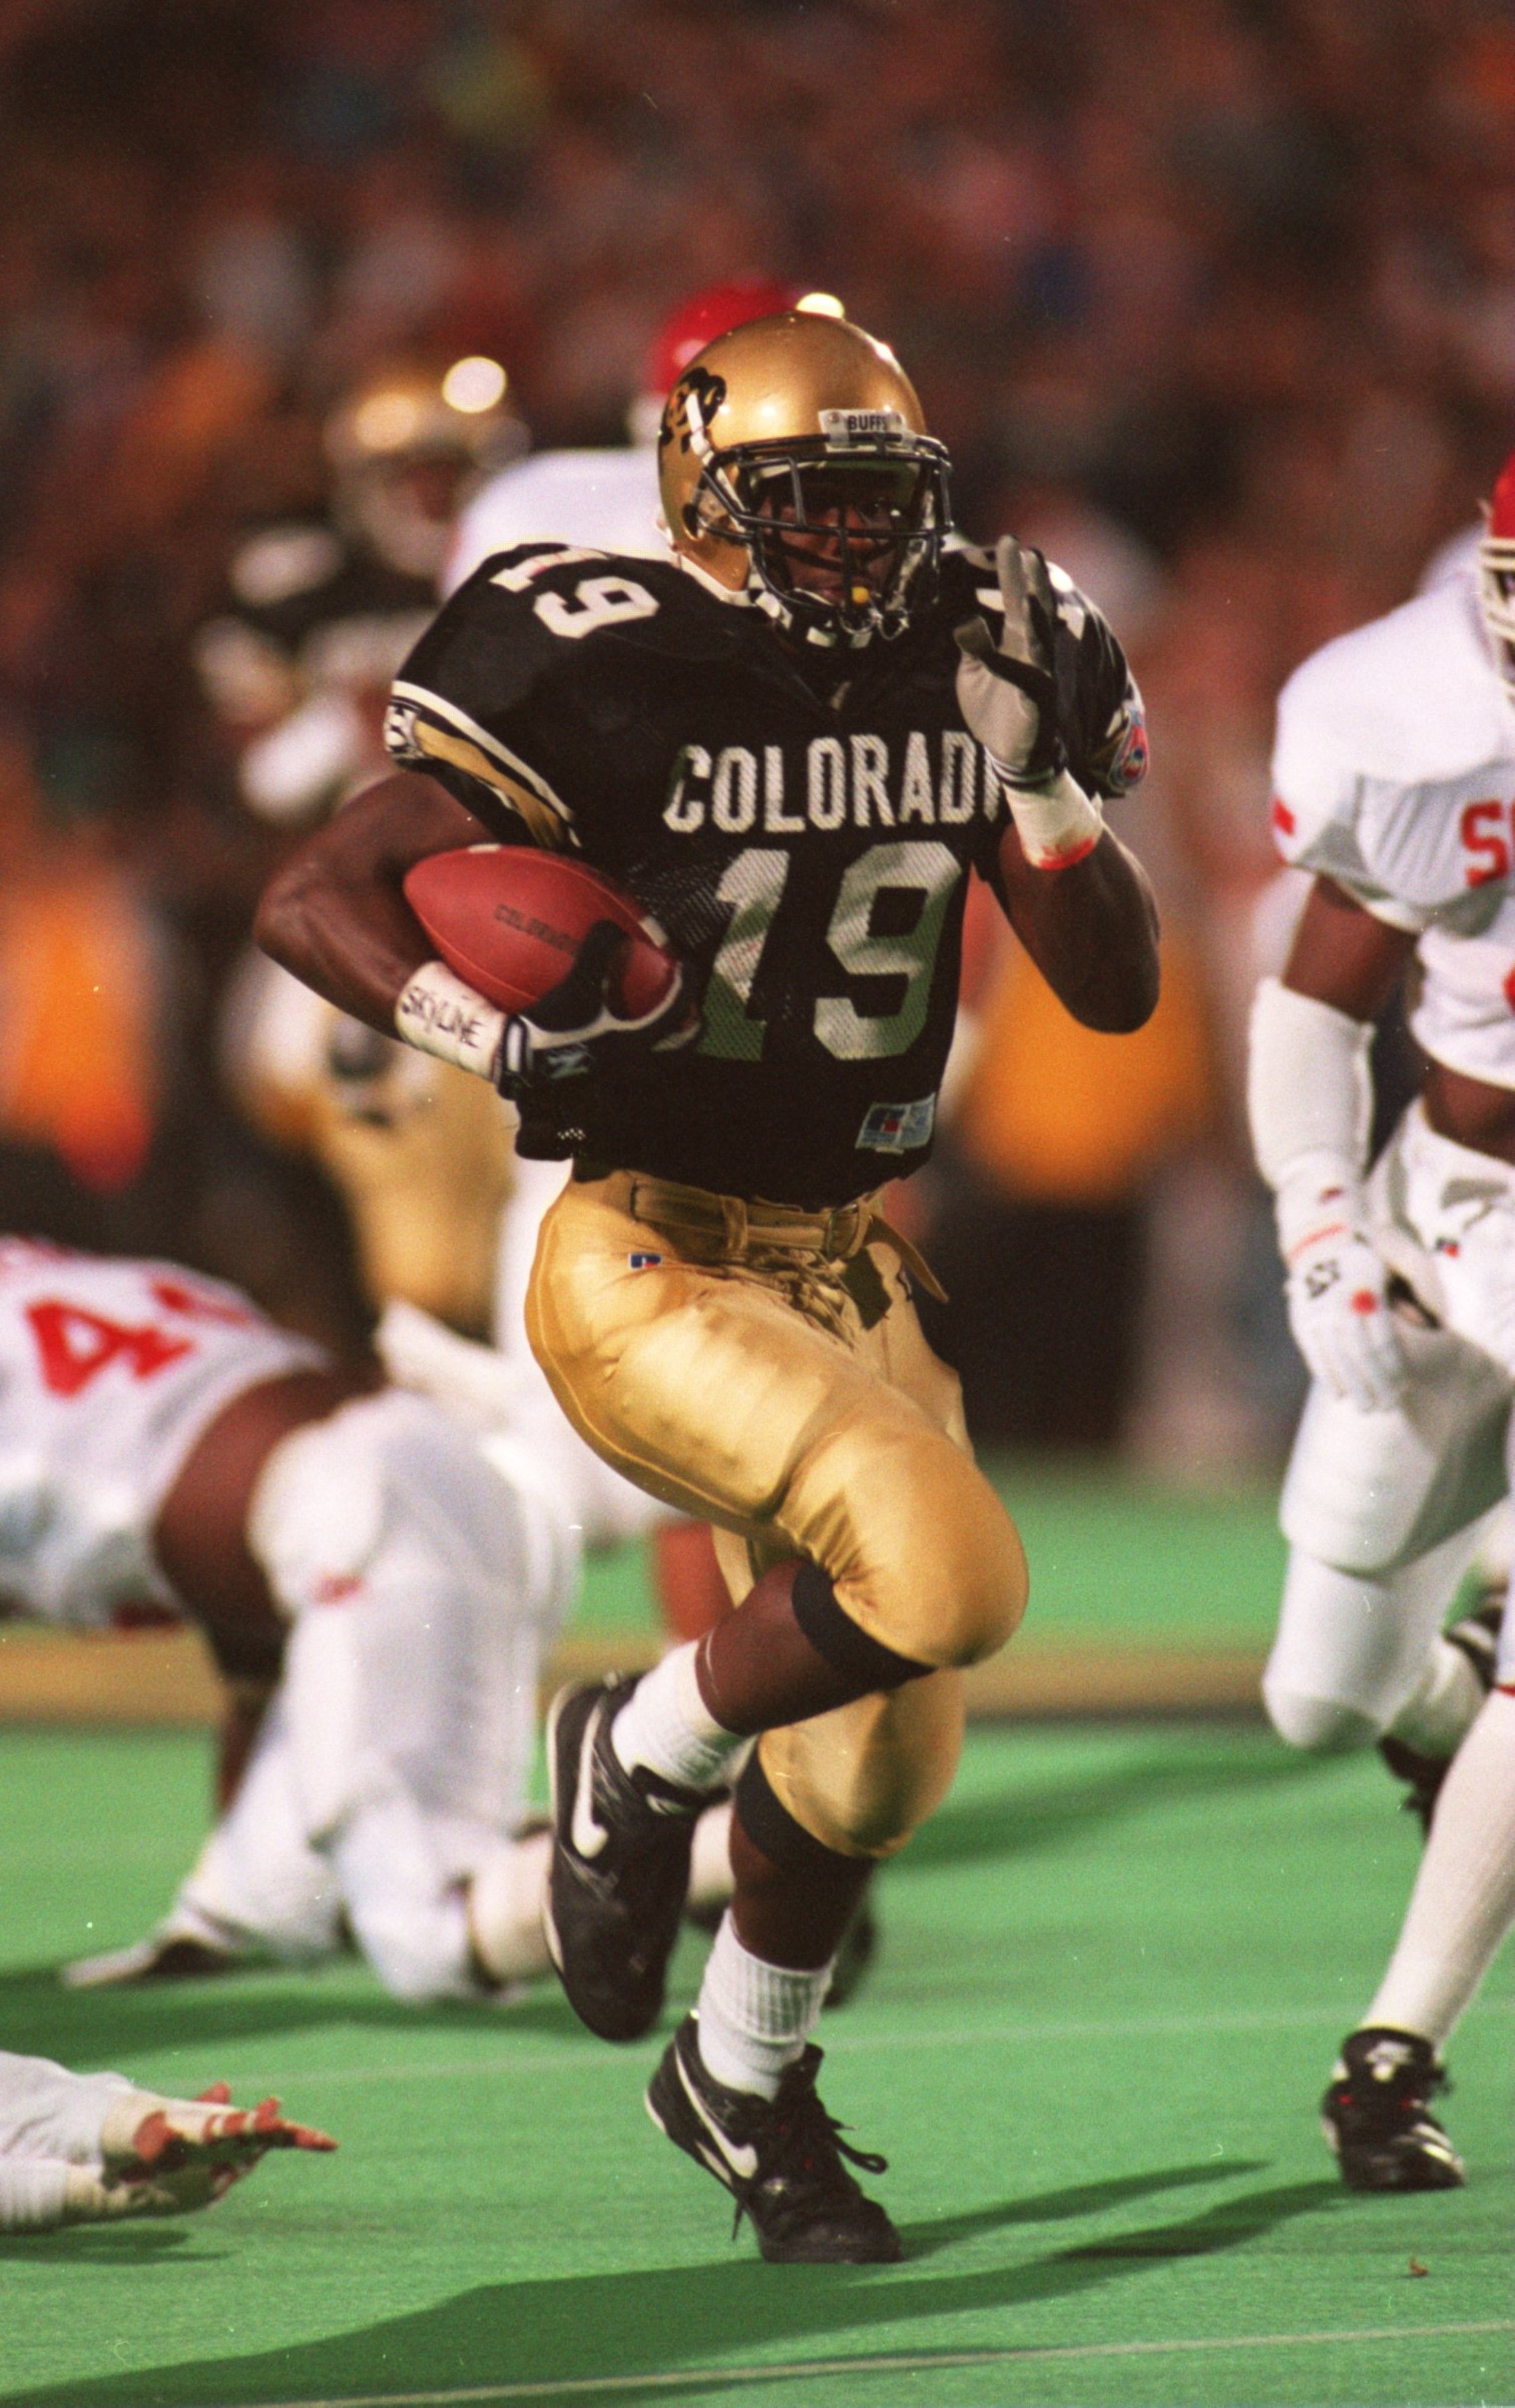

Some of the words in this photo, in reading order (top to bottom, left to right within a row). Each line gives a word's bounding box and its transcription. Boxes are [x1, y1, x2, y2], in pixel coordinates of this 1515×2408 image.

[487, 547, 661, 640] 19
[1459, 799, 1515, 888] S
[695, 840, 963, 1061] 19
